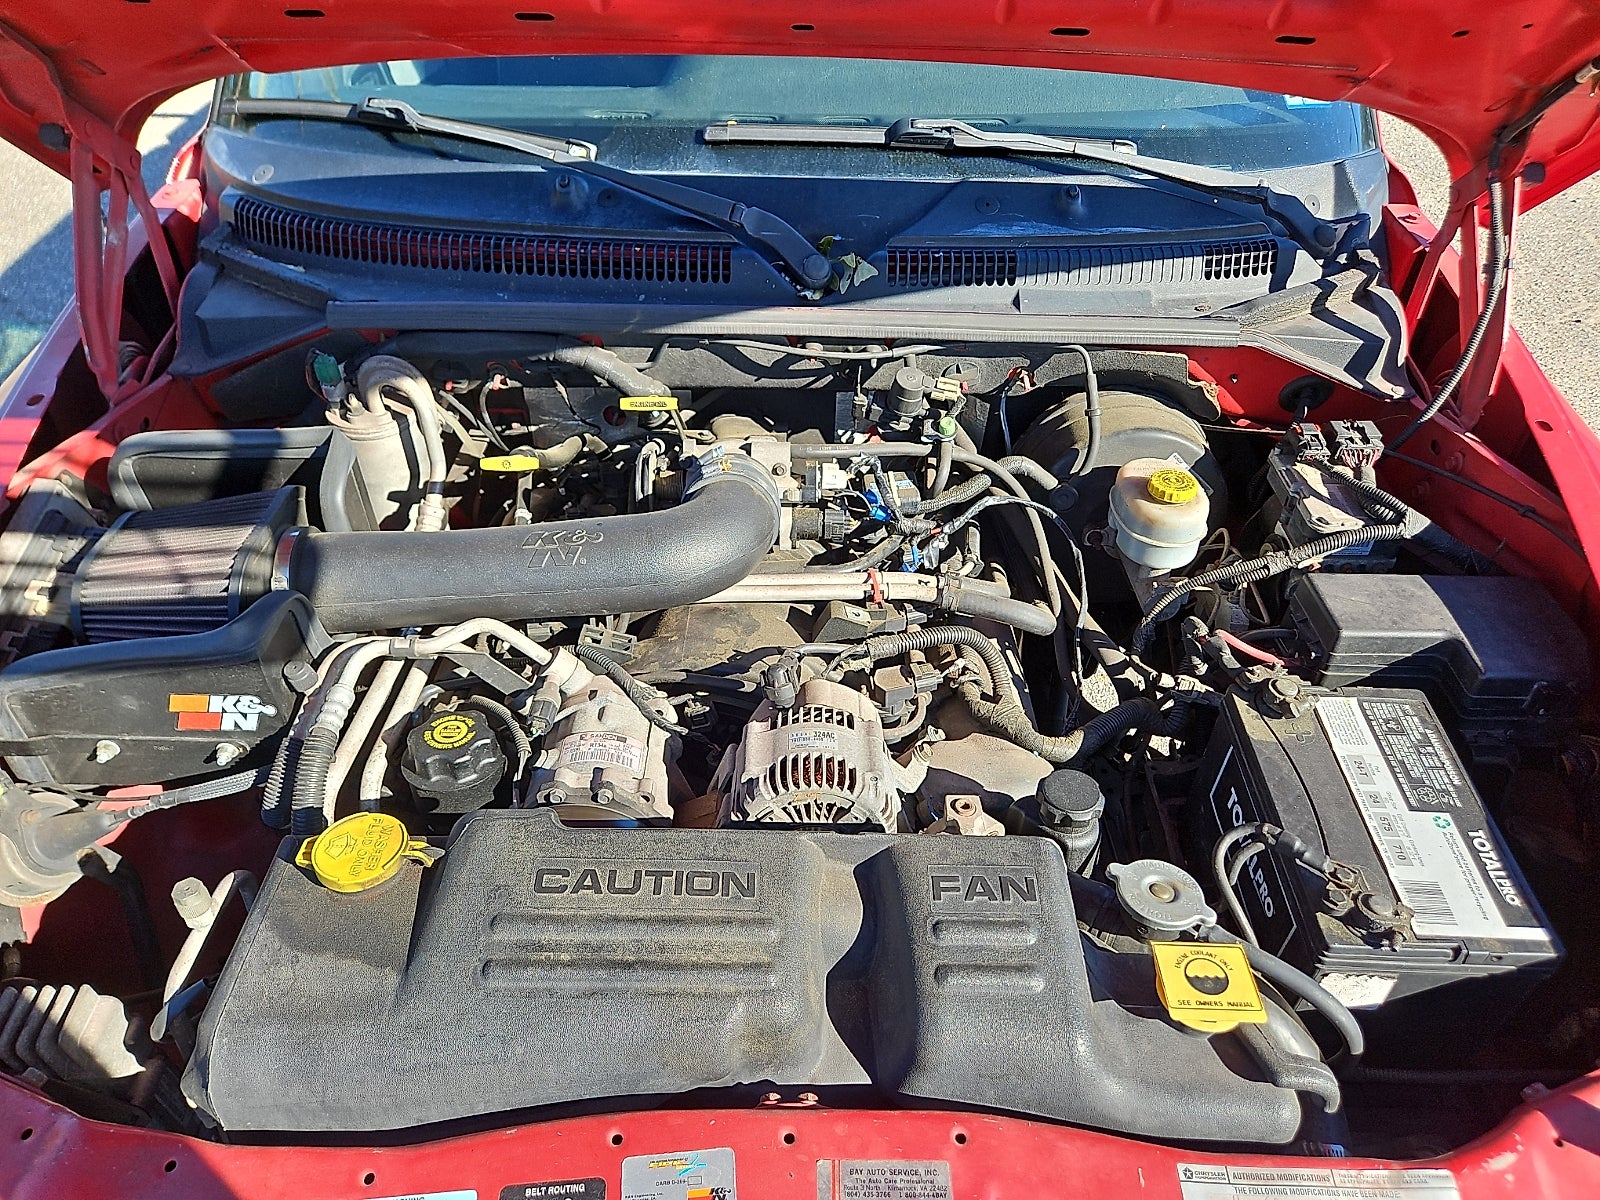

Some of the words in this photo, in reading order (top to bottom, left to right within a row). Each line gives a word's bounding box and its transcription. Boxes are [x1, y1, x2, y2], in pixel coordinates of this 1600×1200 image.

[813, 731, 835, 739] 324AC
[1378, 816, 1393, 831] 575
[361, 818, 384, 846] FLUID
[365, 824, 395, 871] WASHER
[1227, 786, 1274, 918] TOLPRO
[1391, 844, 1407, 860] 710
[349, 849, 368, 877] ONLY
[1467, 829, 1522, 907] TOTALPRO
[534, 868, 755, 898] CAUTION
[931, 875, 1037, 902] FAN
[1219, 958, 1234, 972] ONLY
[849, 1168, 864, 1176] BAY
[866, 1168, 886, 1176] AUTO
[888, 1168, 922, 1177] SERVICE,
[924, 1168, 940, 1176] INC.
[1232, 1172, 1275, 1181] AUTHORIZED
[1276, 1173, 1331, 1182] MODIFICATIONS
[525, 1187, 546, 1197] BELT
[547, 1184, 586, 1195] ROUTING
[1234, 1186, 1248, 1195] THE
[1248, 1187, 1288, 1195] FOLLOWING
[1289, 1188, 1341, 1197] MODIFICATIONS
[1342, 1190, 1359, 1198] HAVE
